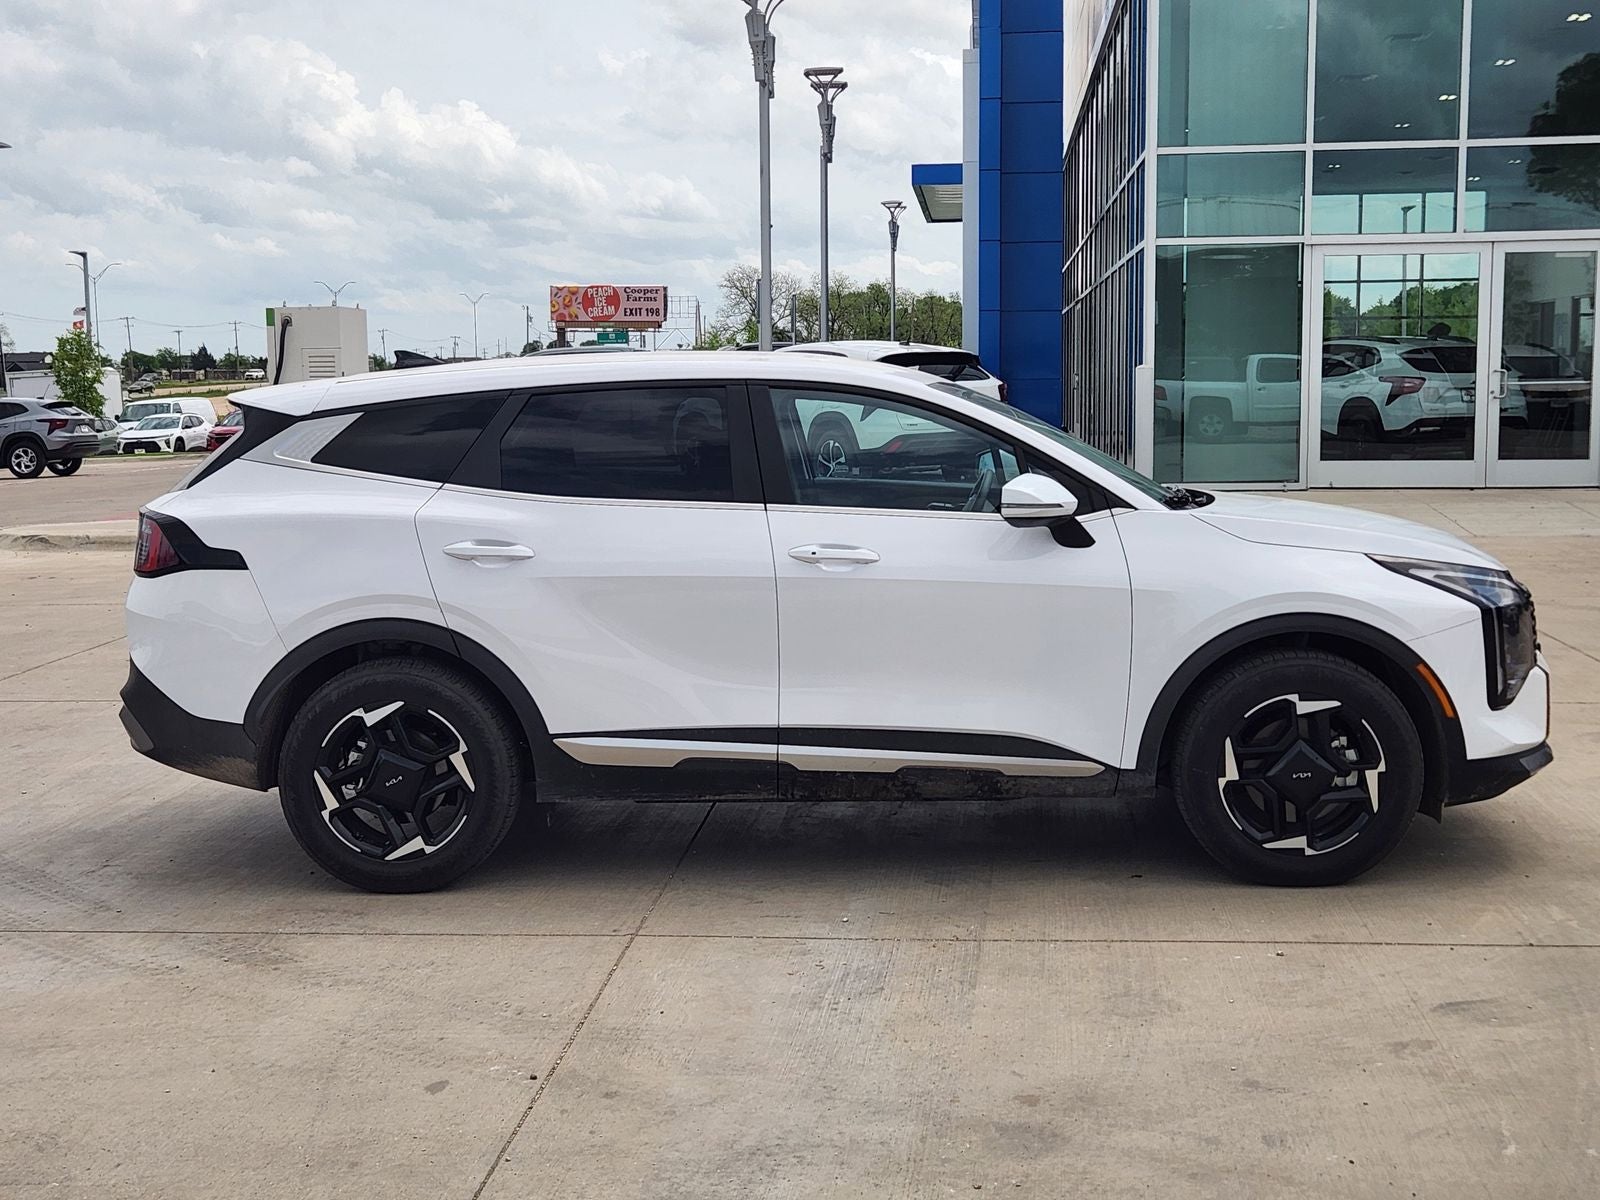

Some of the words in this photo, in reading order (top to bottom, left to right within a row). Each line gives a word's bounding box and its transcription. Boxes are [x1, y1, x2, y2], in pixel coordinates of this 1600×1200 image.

[587, 286, 613, 298] PEACH
[623, 287, 660, 296] Cooper
[594, 297, 607, 307] ICE
[626, 294, 658, 302] Farms
[588, 305, 615, 317] CREAM
[623, 307, 643, 317] EXIT
[645, 307, 660, 317] 198
